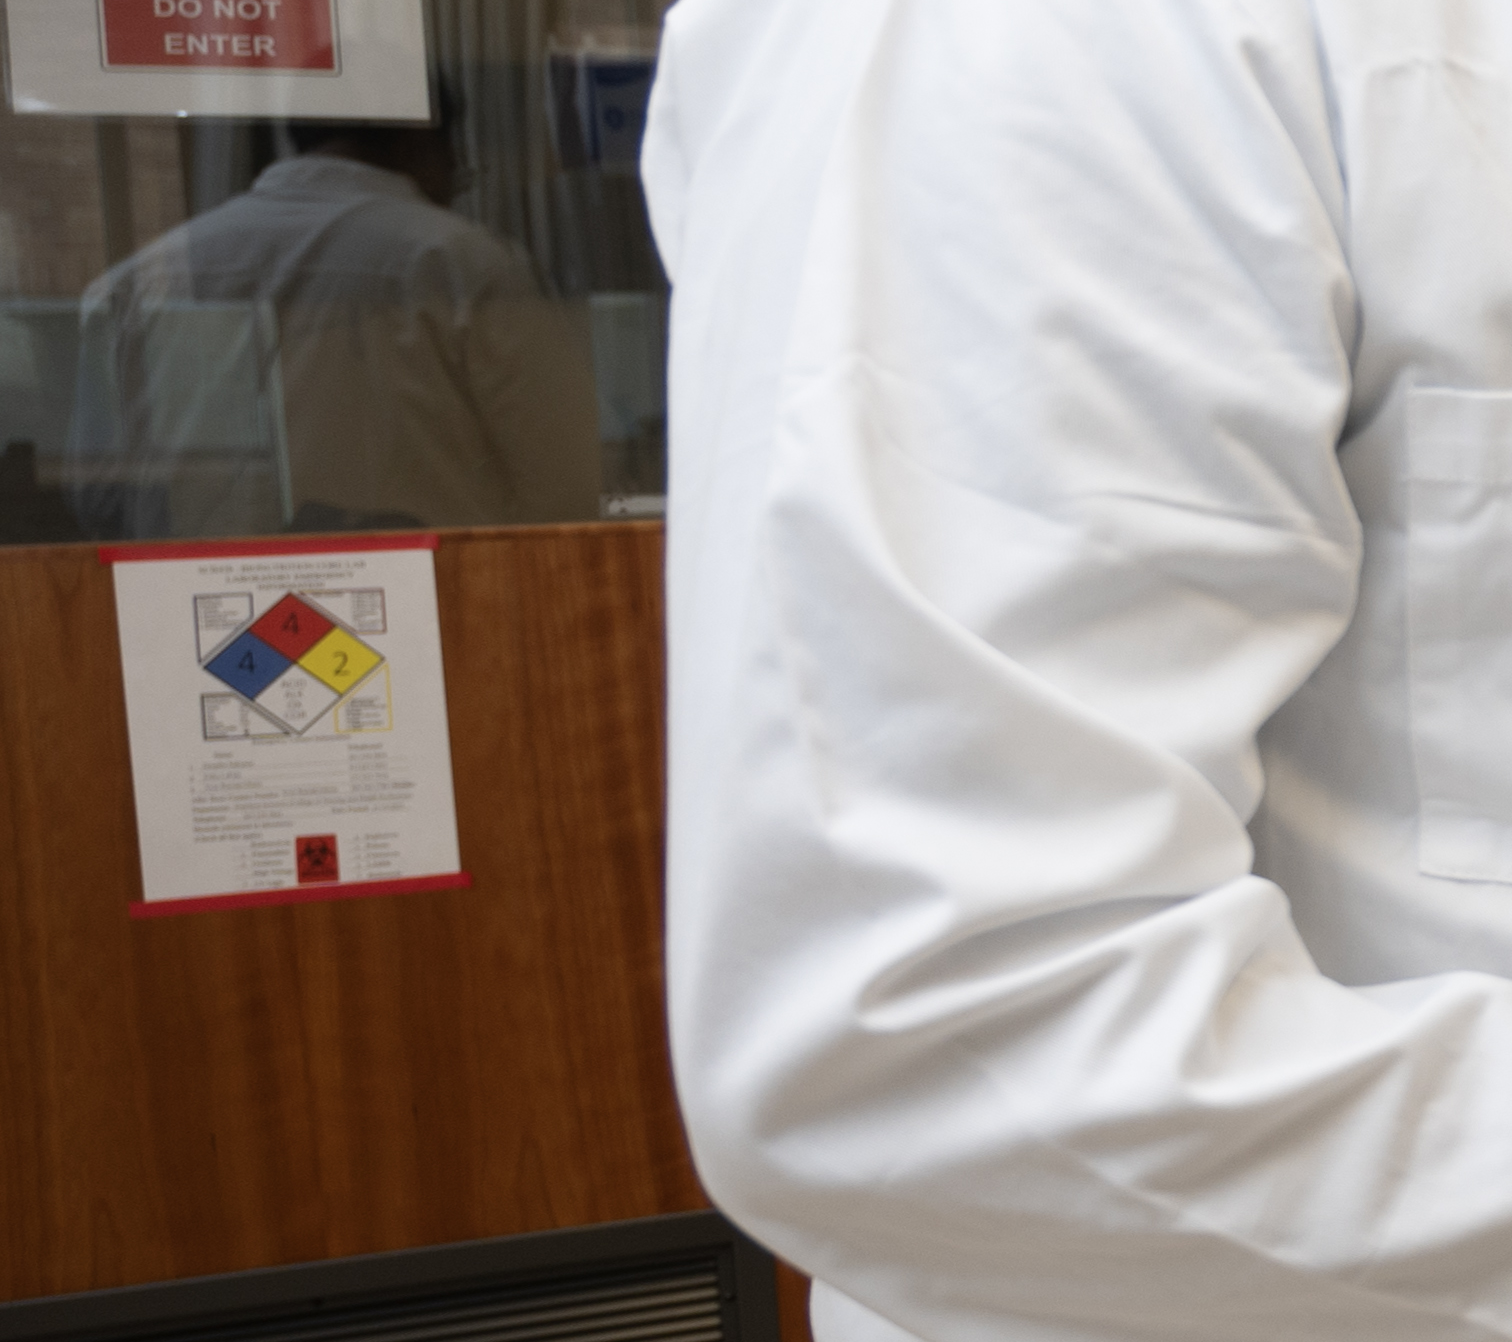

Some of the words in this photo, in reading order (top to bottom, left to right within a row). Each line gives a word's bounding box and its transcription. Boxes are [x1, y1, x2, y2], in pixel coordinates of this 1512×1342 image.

[164, 33, 276, 57] ENTER
[281, 612, 299, 635] 4
[238, 652, 255, 673] 4
[333, 651, 350, 676] 2
